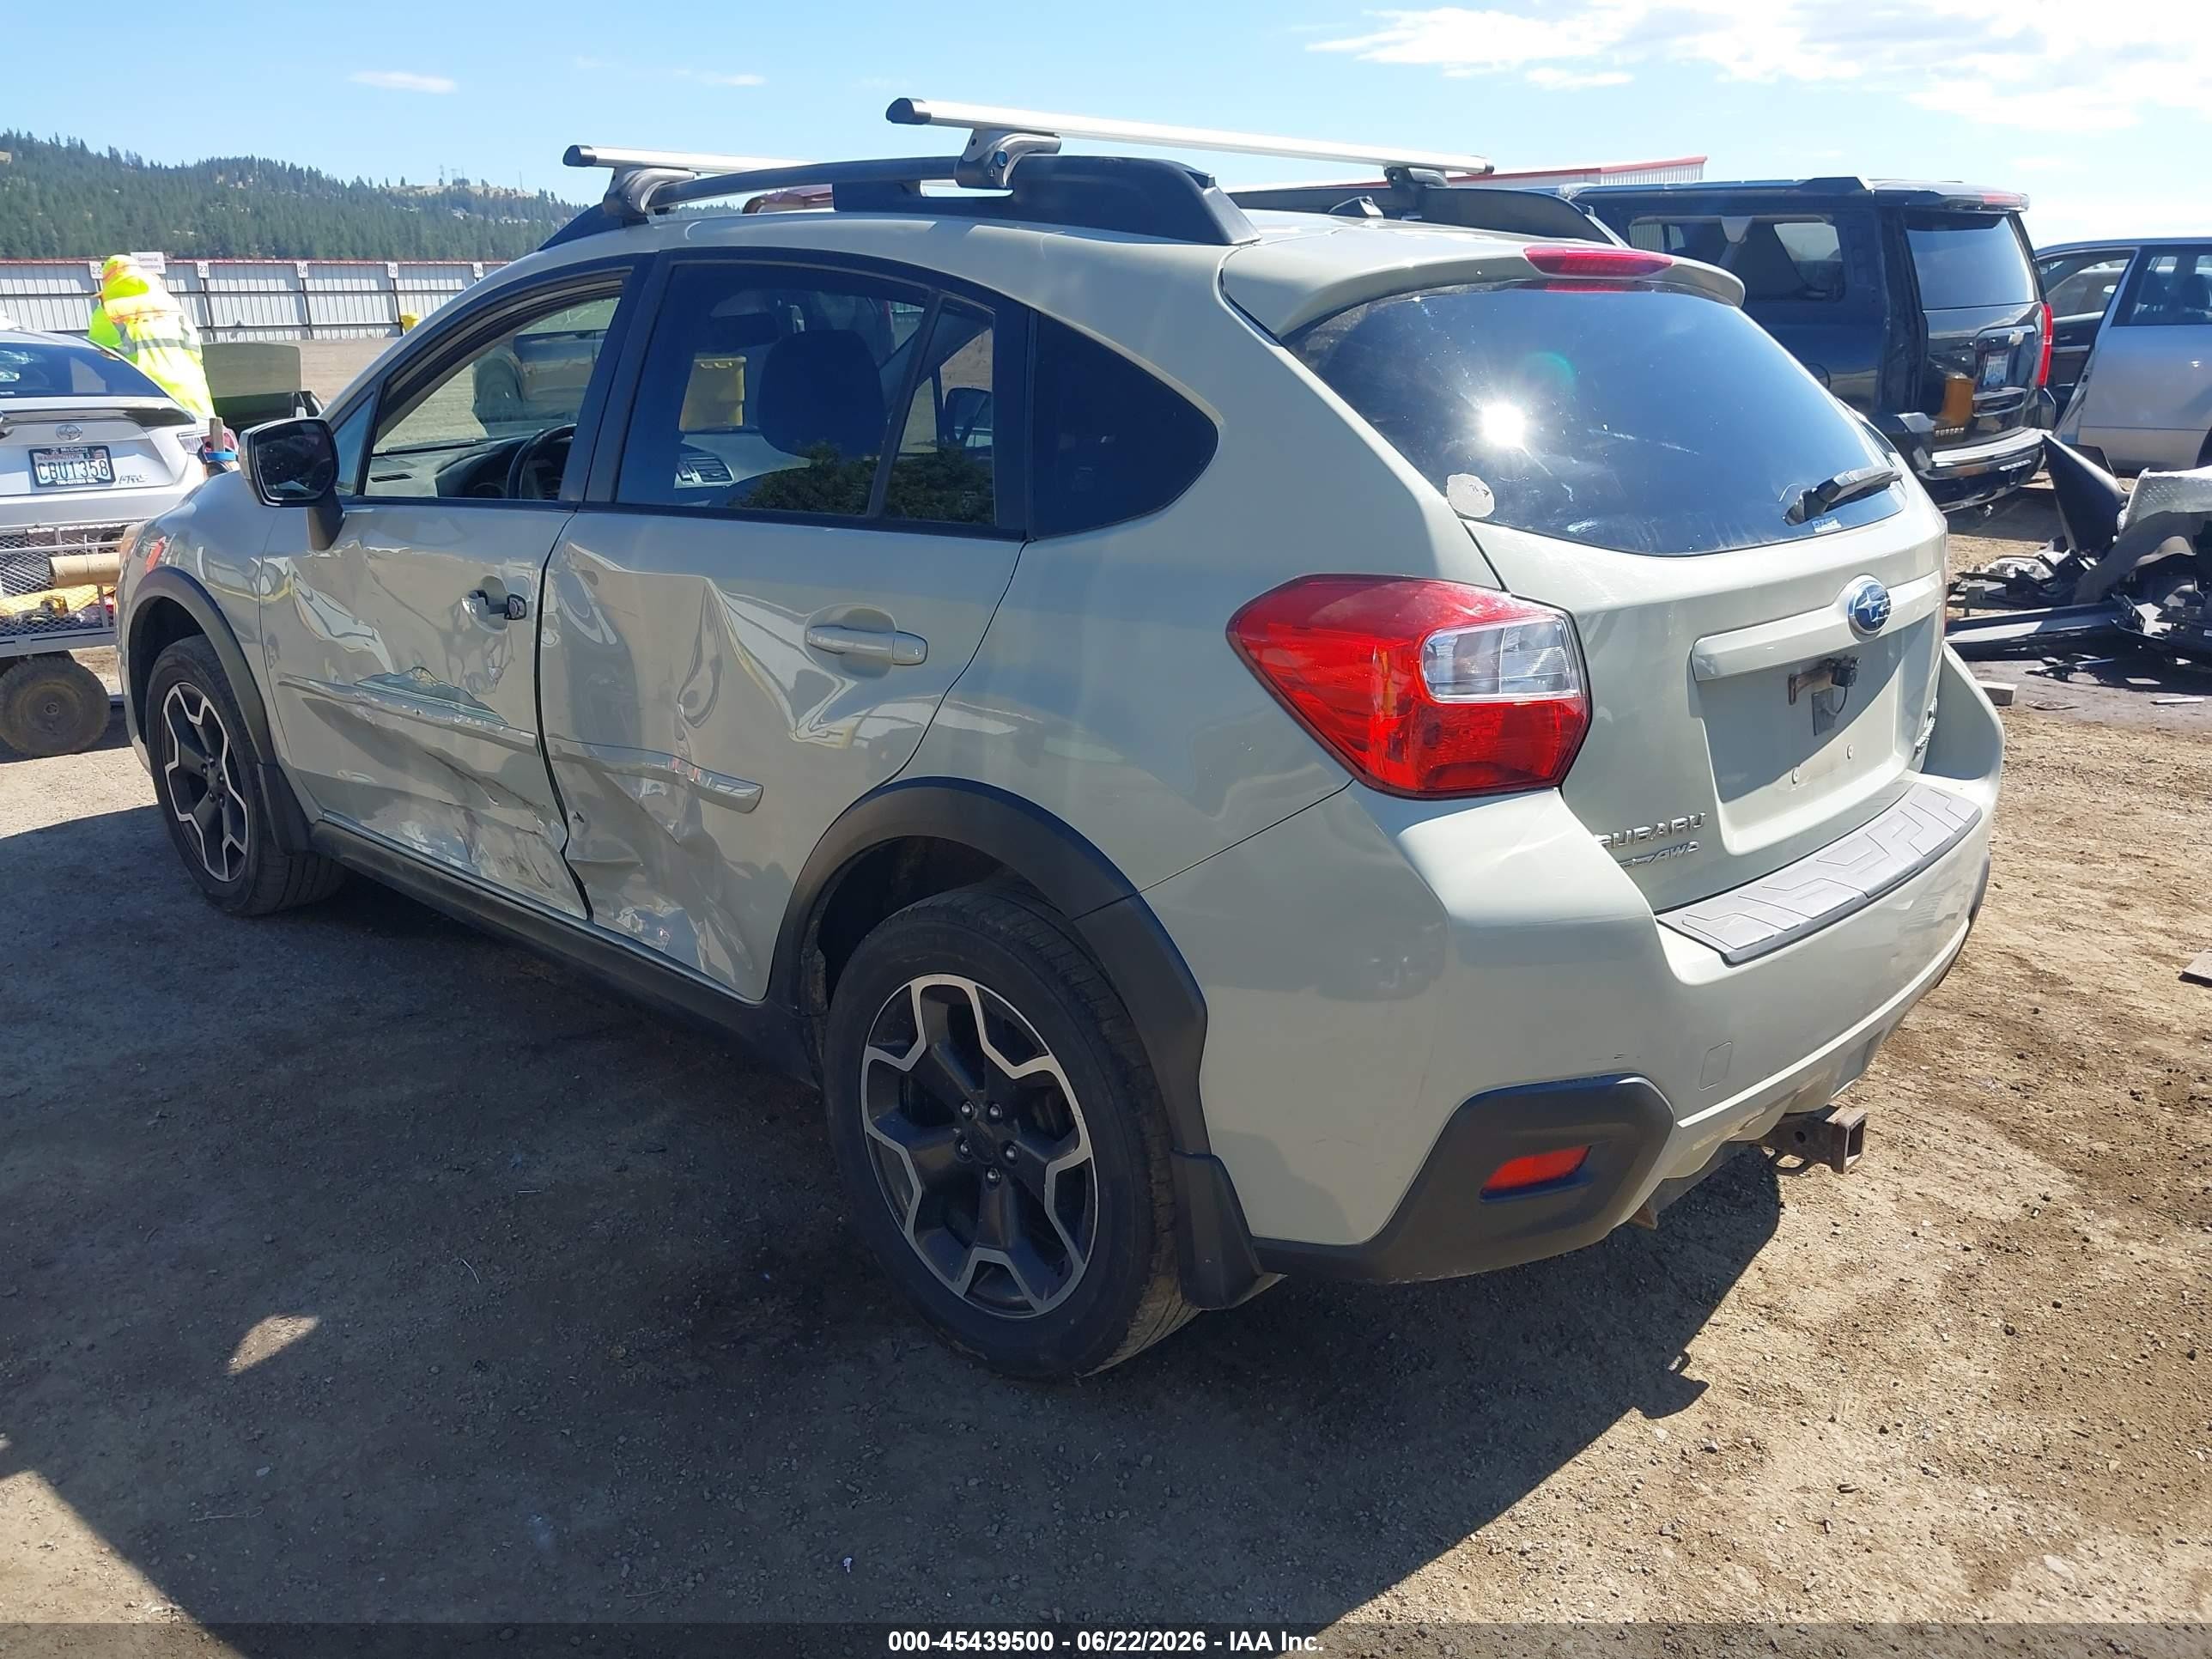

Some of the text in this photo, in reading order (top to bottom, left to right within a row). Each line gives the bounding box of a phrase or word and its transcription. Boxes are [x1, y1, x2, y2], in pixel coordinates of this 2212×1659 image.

[91, 265, 102, 275] 22
[198, 265, 208, 274] 23
[38, 460, 108, 480] CBU1358
[1594, 812, 1706, 848] SUBARU
